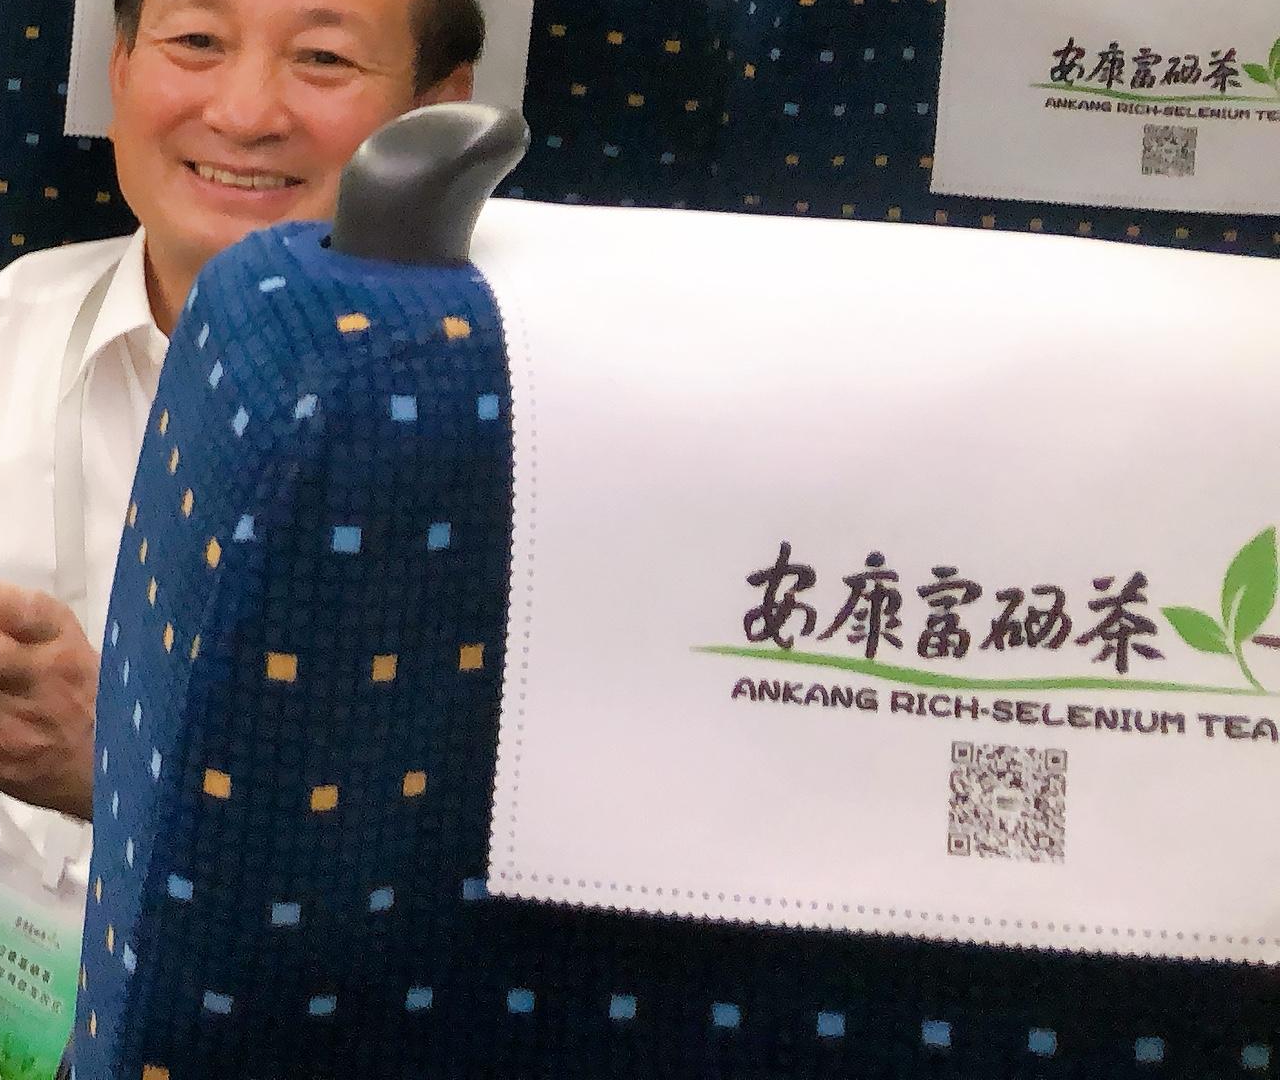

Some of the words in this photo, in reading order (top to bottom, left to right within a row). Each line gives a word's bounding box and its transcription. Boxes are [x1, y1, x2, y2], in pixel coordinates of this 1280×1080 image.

[1049, 36, 1242, 94] 安康富硒茶
[1044, 96, 1112, 113] ANKANG
[1255, 109, 1280, 122] TE
[742, 541, 1167, 675] 安康富硒茶
[730, 675, 879, 713] ANKANG
[889, 689, 1186, 737] RICH-SELENIUM
[1197, 711, 1280, 743] TEA
